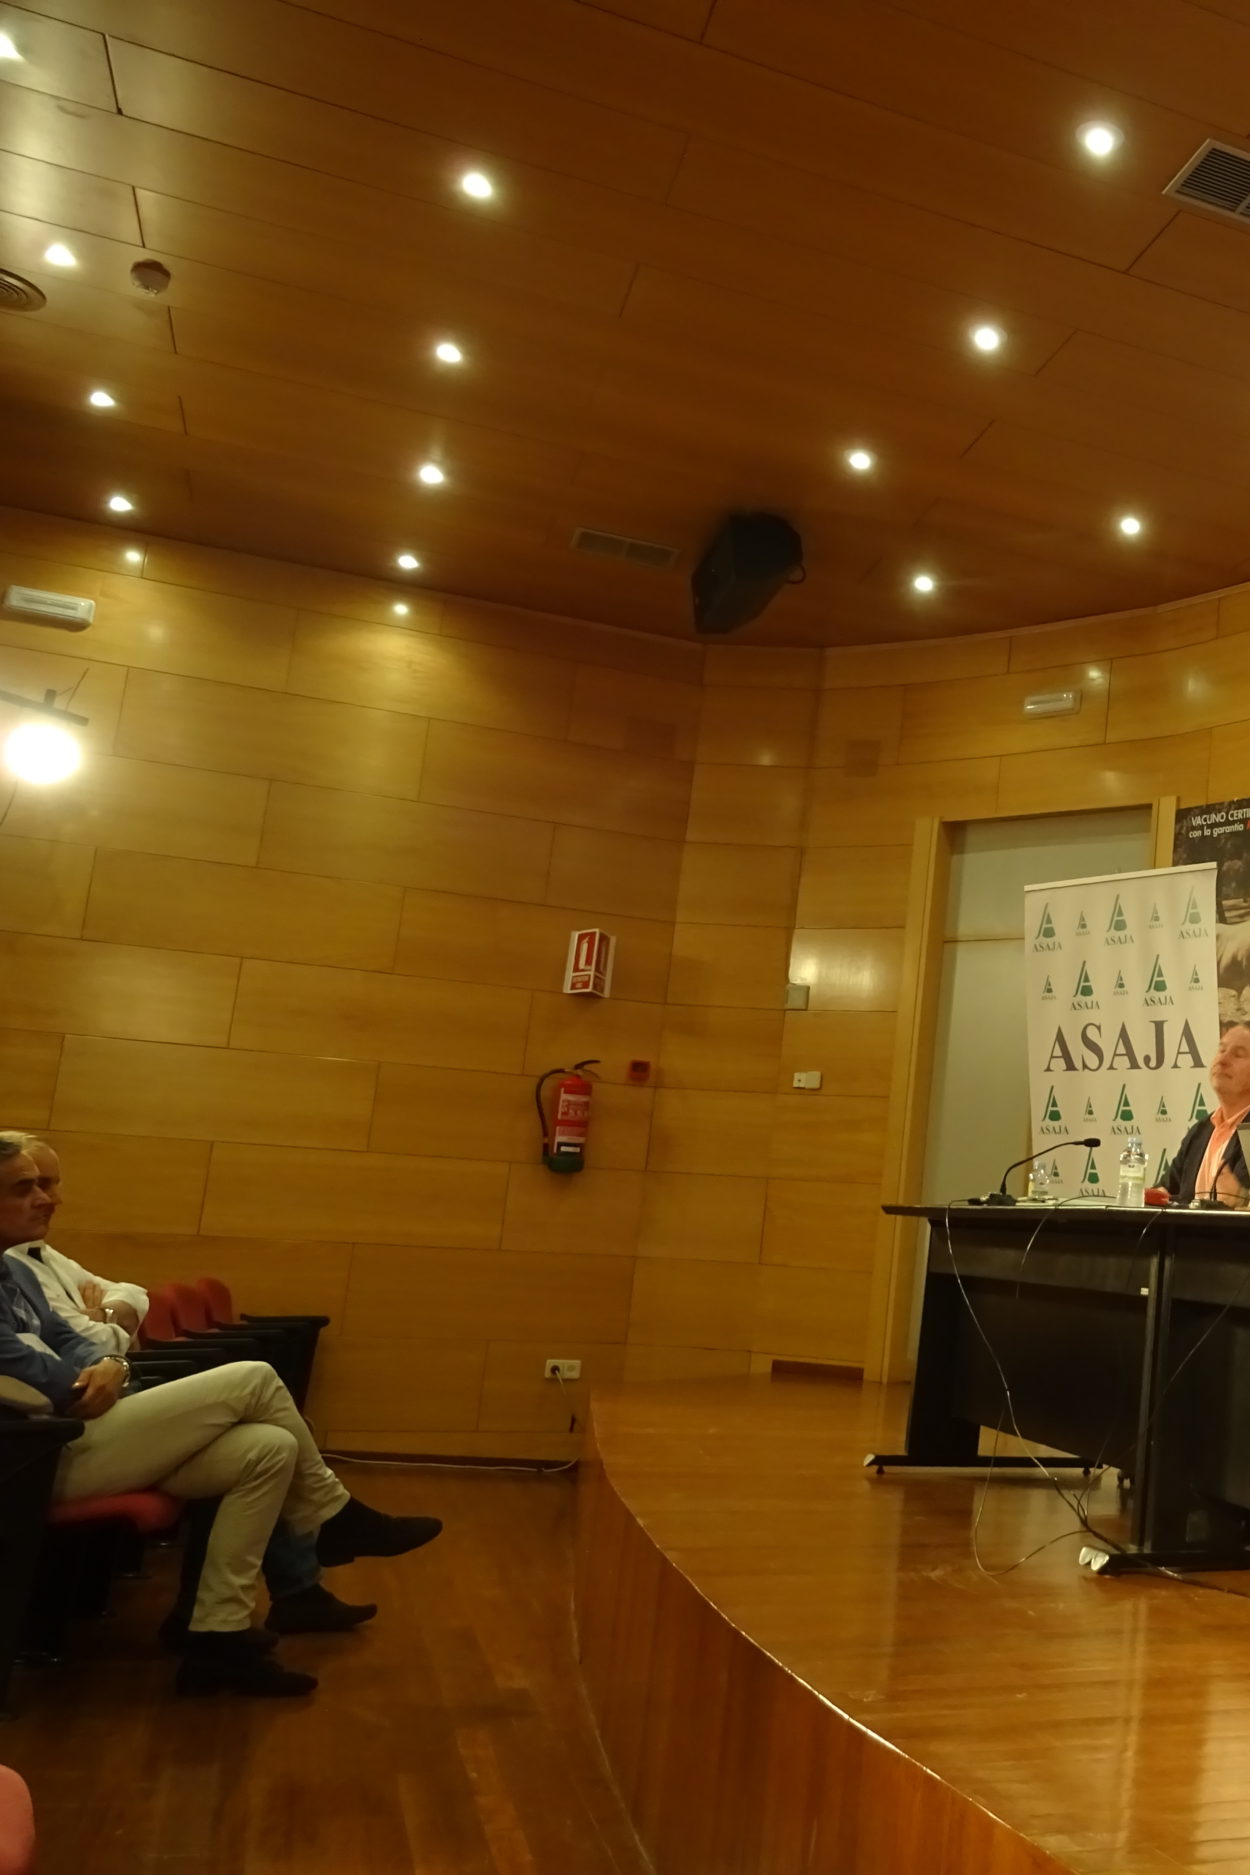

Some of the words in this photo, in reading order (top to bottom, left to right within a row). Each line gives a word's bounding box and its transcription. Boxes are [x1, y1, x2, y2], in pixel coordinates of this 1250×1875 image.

[1191, 812, 1226, 826] VACUNO
[1189, 830, 1202, 838] con
[1203, 826, 1211, 836] la
[1213, 822, 1244, 837] garantía
[1104, 934, 1135, 946] ASAJA
[1177, 928, 1208, 940] ASAJA
[1033, 941, 1062, 953] ASAJA
[1070, 1000, 1101, 1011] ASAJA
[1142, 995, 1175, 1007] ASAJA
[1043, 1018, 1207, 1073] ASAJA
[1039, 1125, 1069, 1136] ASAJA
[1110, 1125, 1141, 1136] ASAJA
